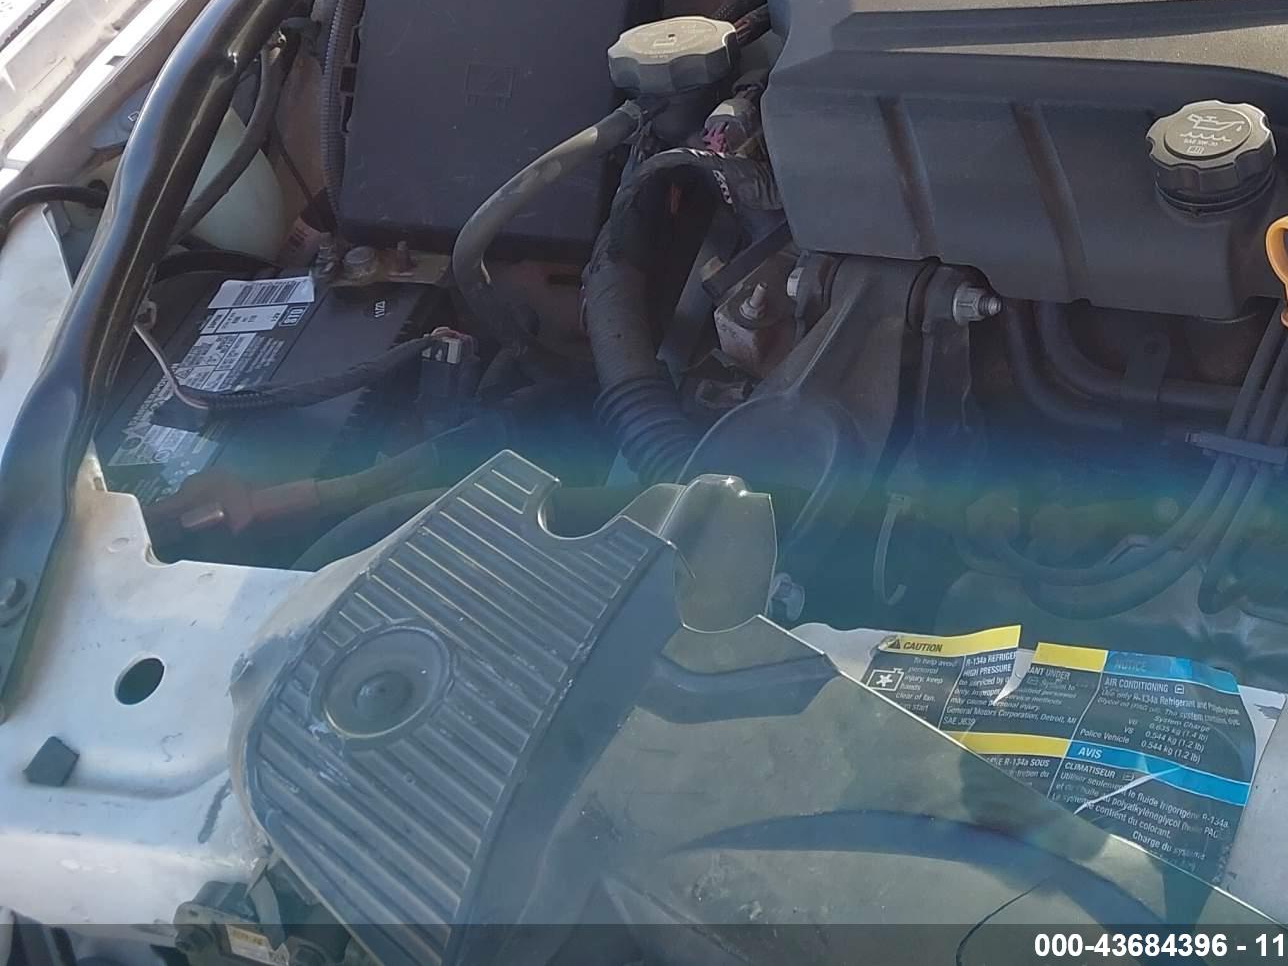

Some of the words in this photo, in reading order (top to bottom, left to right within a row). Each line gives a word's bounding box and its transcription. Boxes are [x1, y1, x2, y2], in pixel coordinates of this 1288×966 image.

[903, 641, 943, 652] CAUTION
[962, 669, 979, 679] HIGH
[980, 663, 1012, 675] PRESSURE
[1045, 669, 1071, 681] UNDER
[1104, 677, 1118, 688] AIR
[1118, 678, 1169, 694] CONDITIONING
[946, 706, 974, 715] General
[974, 707, 998, 717] Motors
[1079, 728, 1103, 737] Police
[1103, 731, 1130, 744] Vehicle
[1163, 744, 1174, 756] kg
[1190, 751, 1201, 763] lb)
[1167, 734, 1178, 746] kg
[1077, 746, 1103, 760] AVIS
[1029, 758, 1050, 767] SOUS
[1064, 761, 1116, 779] CLIMATISEUR
[1094, 802, 1126, 822] contient
[1127, 814, 1138, 826] du
[1138, 819, 1172, 839] colorant.
[1132, 829, 1161, 849] Charge
[1161, 842, 1172, 853] du
